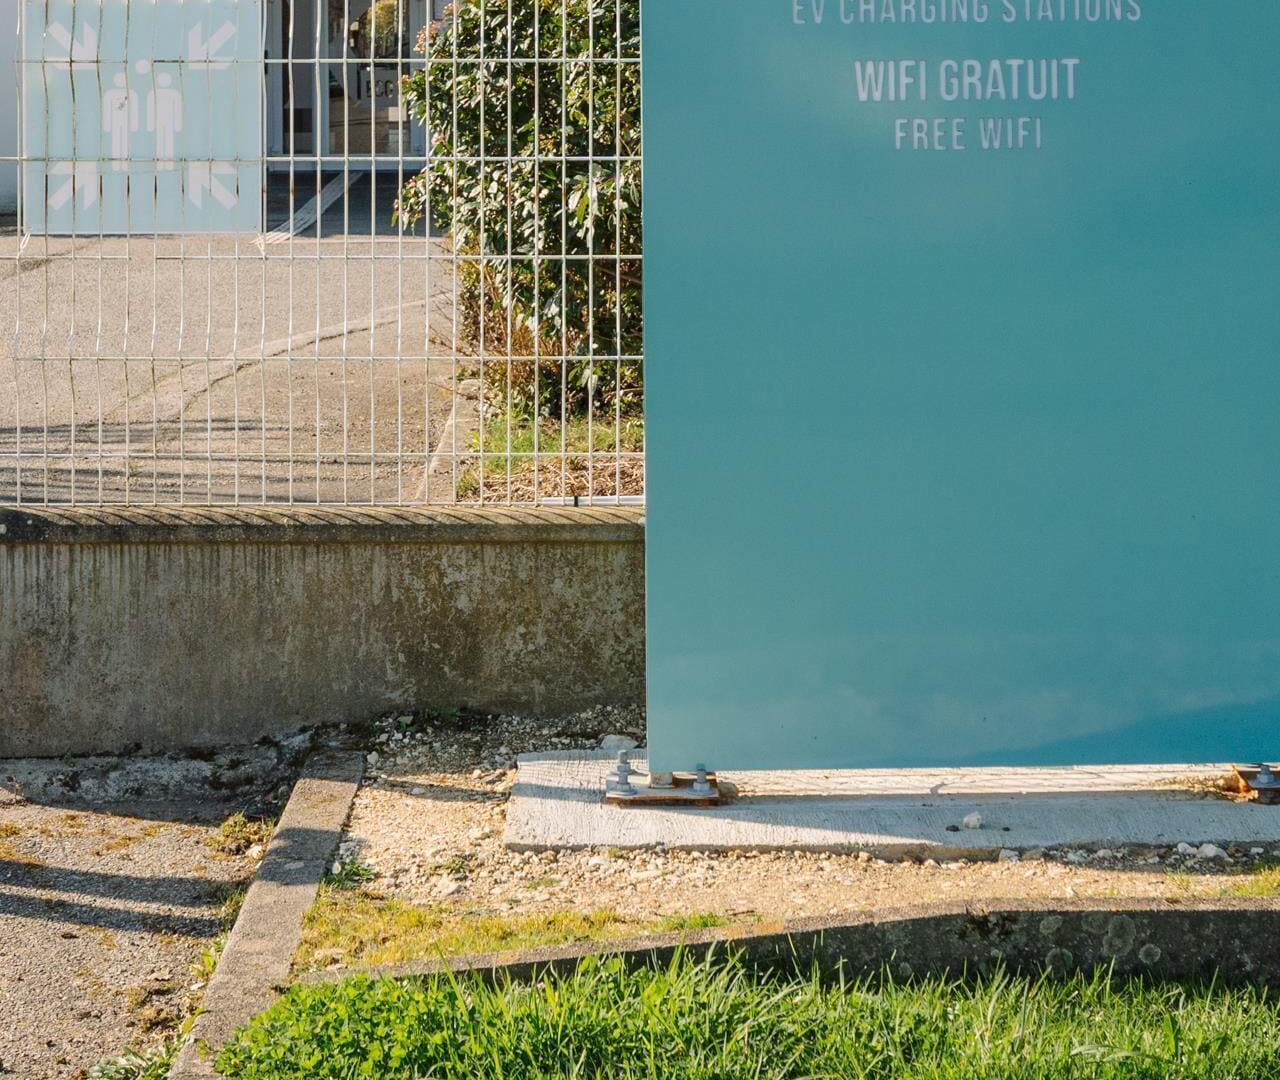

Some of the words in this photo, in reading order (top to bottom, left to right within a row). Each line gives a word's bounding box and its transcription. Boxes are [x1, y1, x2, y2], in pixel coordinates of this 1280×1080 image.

[854, 60, 926, 100] WIFI
[939, 59, 1080, 100] GRATUIT
[895, 119, 965, 149] FREE
[980, 118, 1042, 148] WIFI
